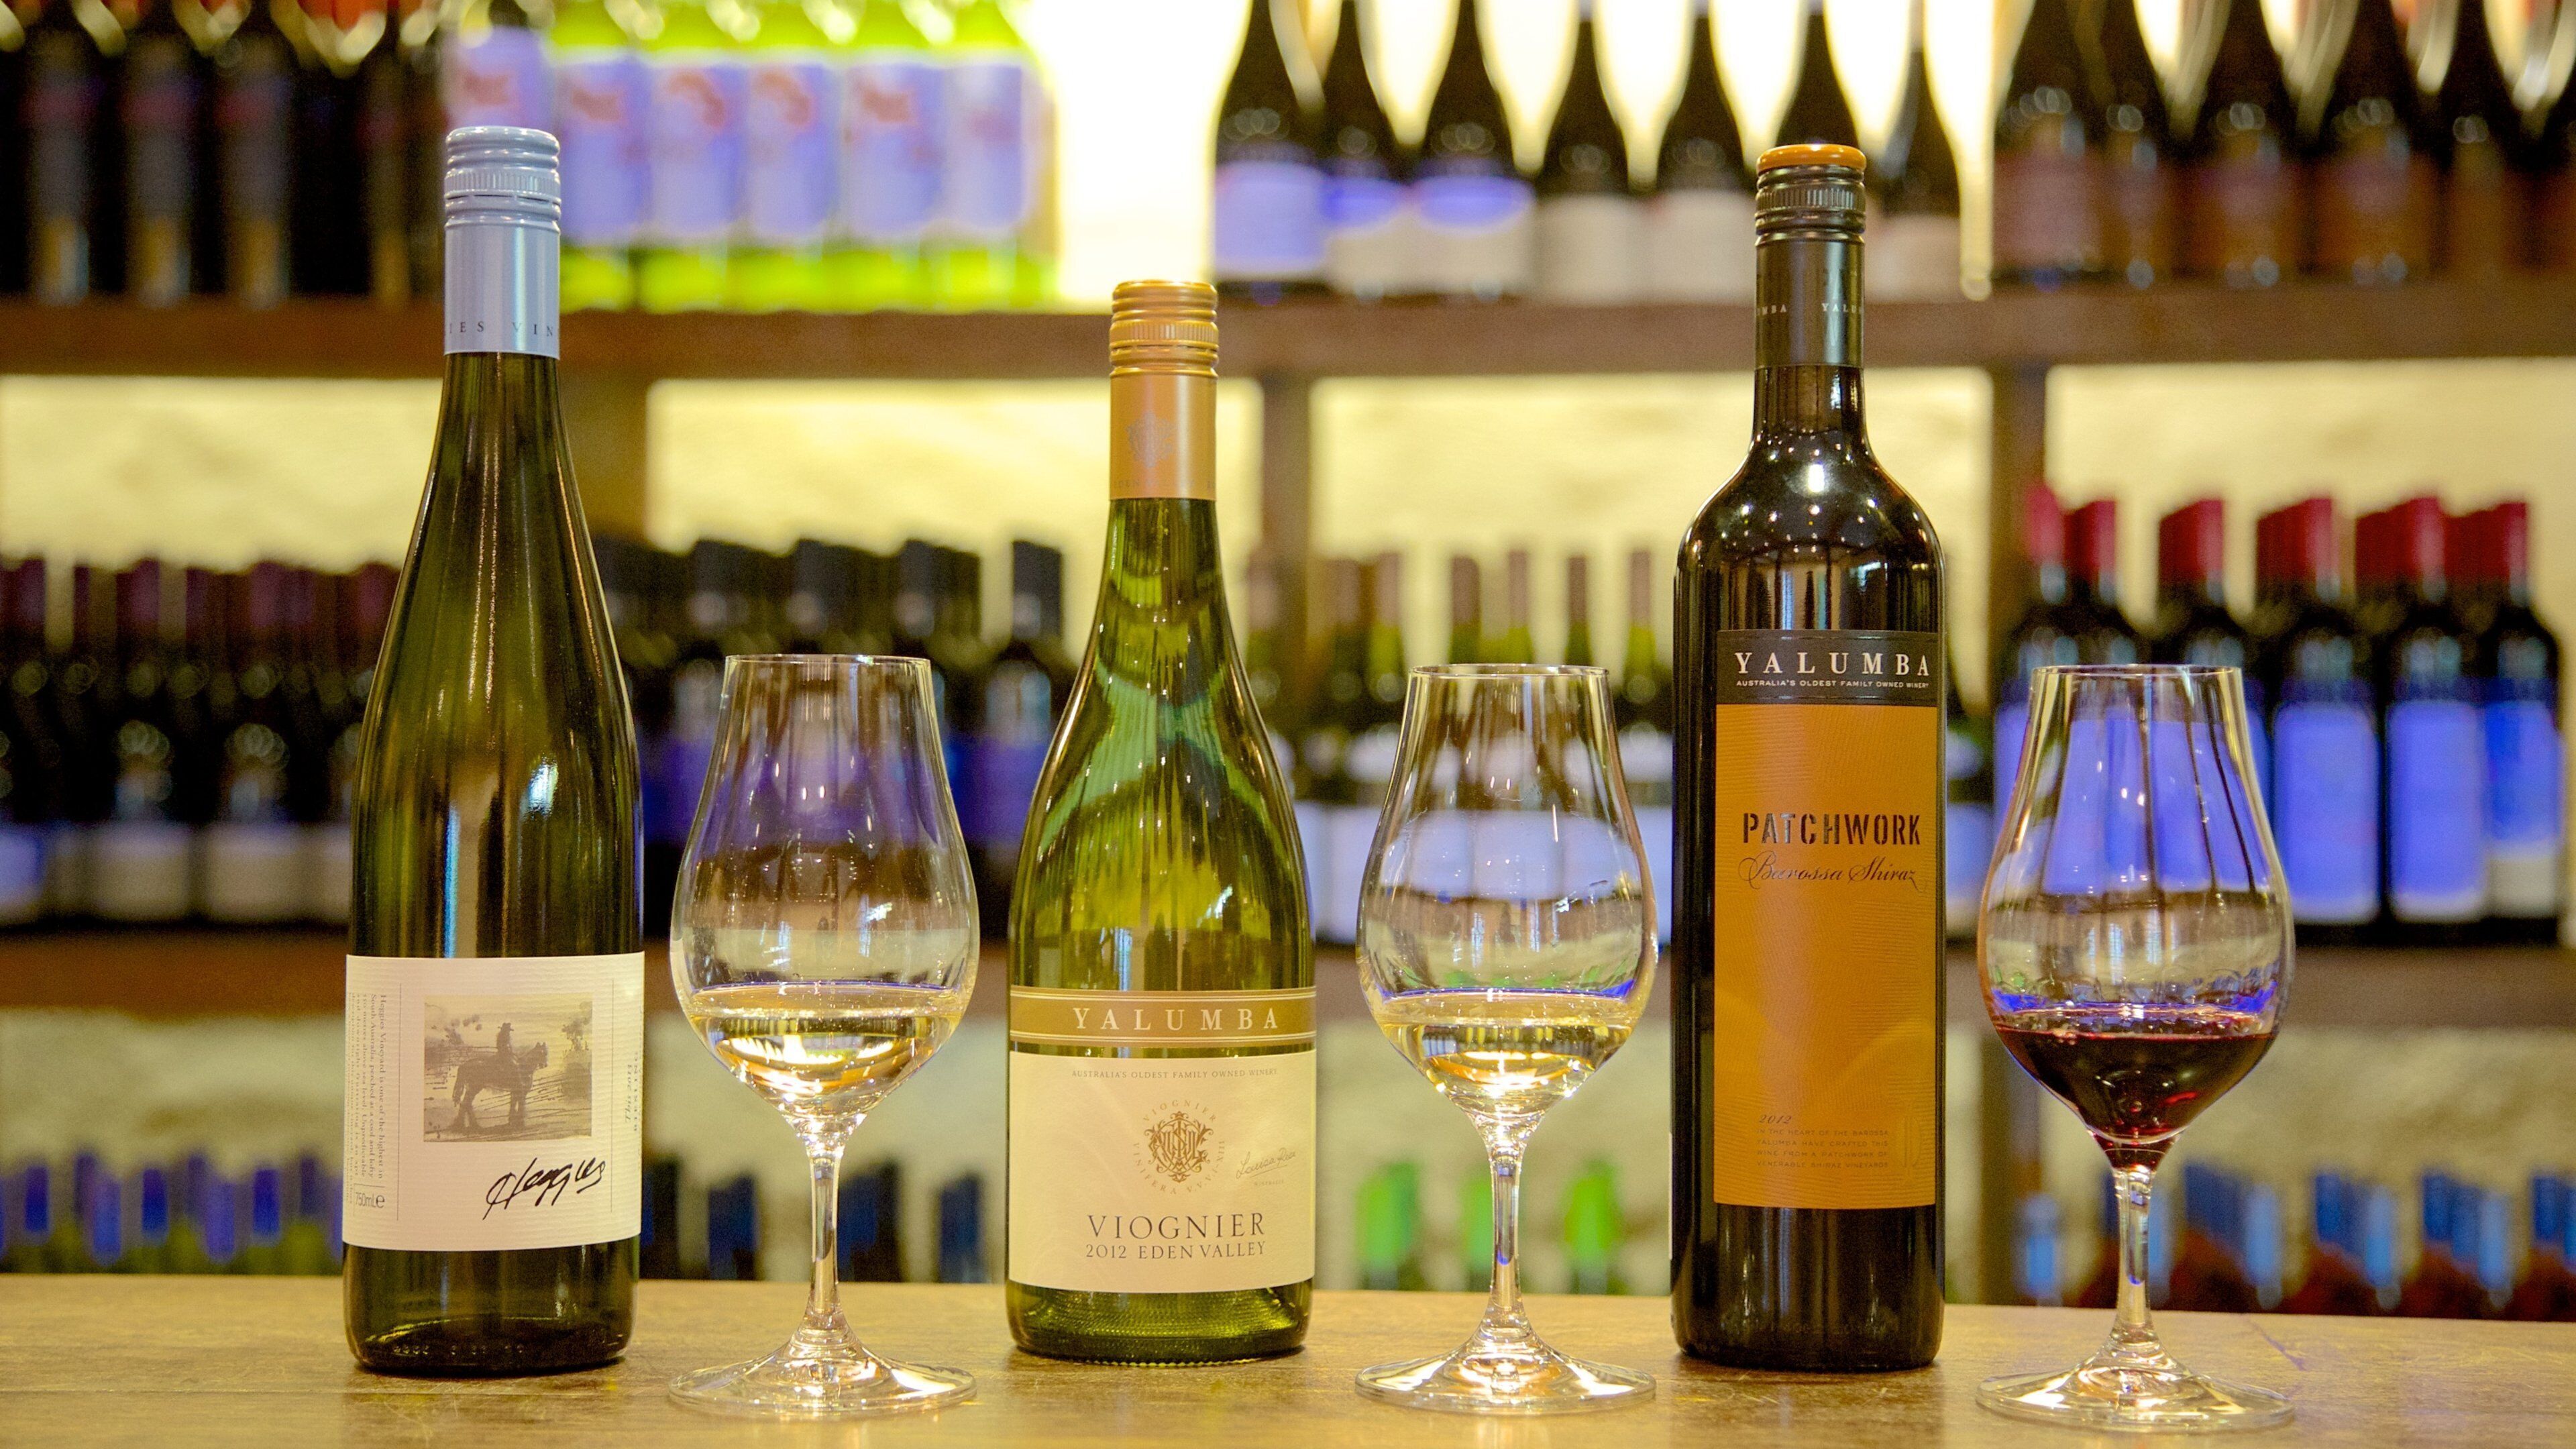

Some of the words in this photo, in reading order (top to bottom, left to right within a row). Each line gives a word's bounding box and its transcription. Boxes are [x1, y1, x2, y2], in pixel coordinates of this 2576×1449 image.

[1734, 652, 1929, 676] YALUMBA
[1742, 812, 1921, 845] PATCHWORK
[1739, 851, 1843, 891] Barossa
[1847, 856, 1927, 893] Shiraz
[1073, 1008, 1279, 1030] YALUMBA
[378, 1033, 386, 1073] Vineyard
[1072, 1070, 1128, 1078] AUSTRALIA'S
[1212, 1070, 1246, 1078] OWNED
[1248, 1068, 1278, 1076] WINERY
[379, 1106, 386, 1115] of
[1142, 1099, 1217, 1122] VIOGNIER
[1758, 1114, 1793, 1124] 2012
[377, 1135, 386, 1166] highest
[378, 1171, 384, 1179] in
[1133, 1142, 1177, 1195] VINIFERA
[1087, 1212, 1265, 1240] VIOGNIER
[1085, 1244, 1127, 1258] 2012
[1138, 1245, 1194, 1259] EDEN
[1199, 1241, 1266, 1258] VALLEY
